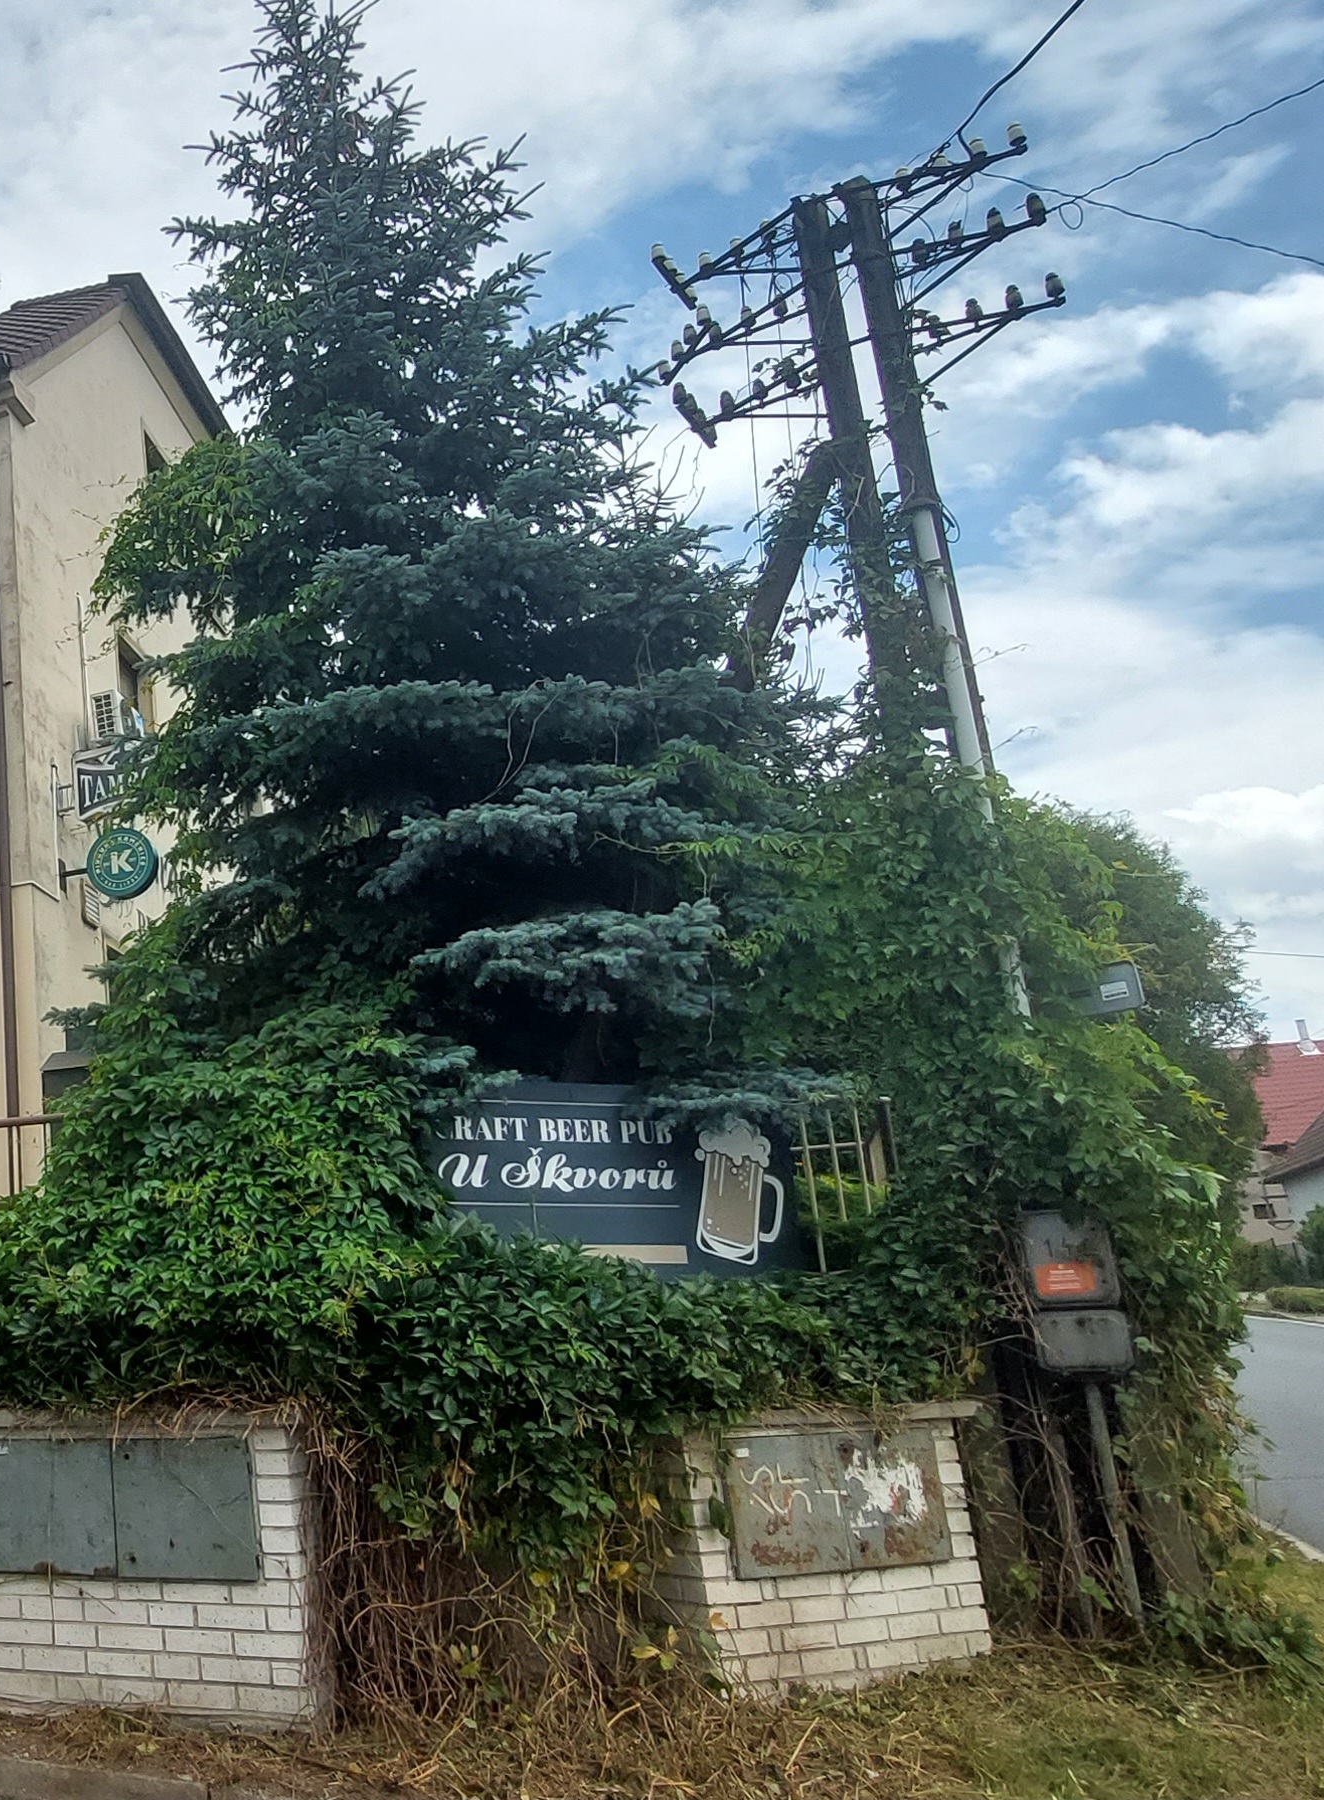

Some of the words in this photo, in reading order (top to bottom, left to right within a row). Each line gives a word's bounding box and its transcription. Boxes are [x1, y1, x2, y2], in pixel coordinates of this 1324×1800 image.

[110, 848, 135, 875] K
[538, 1117, 611, 1144] BEER
[619, 1119, 674, 1145] PUB
[438, 1153, 490, 1189] U
[500, 1147, 677, 1193] Škvorů
